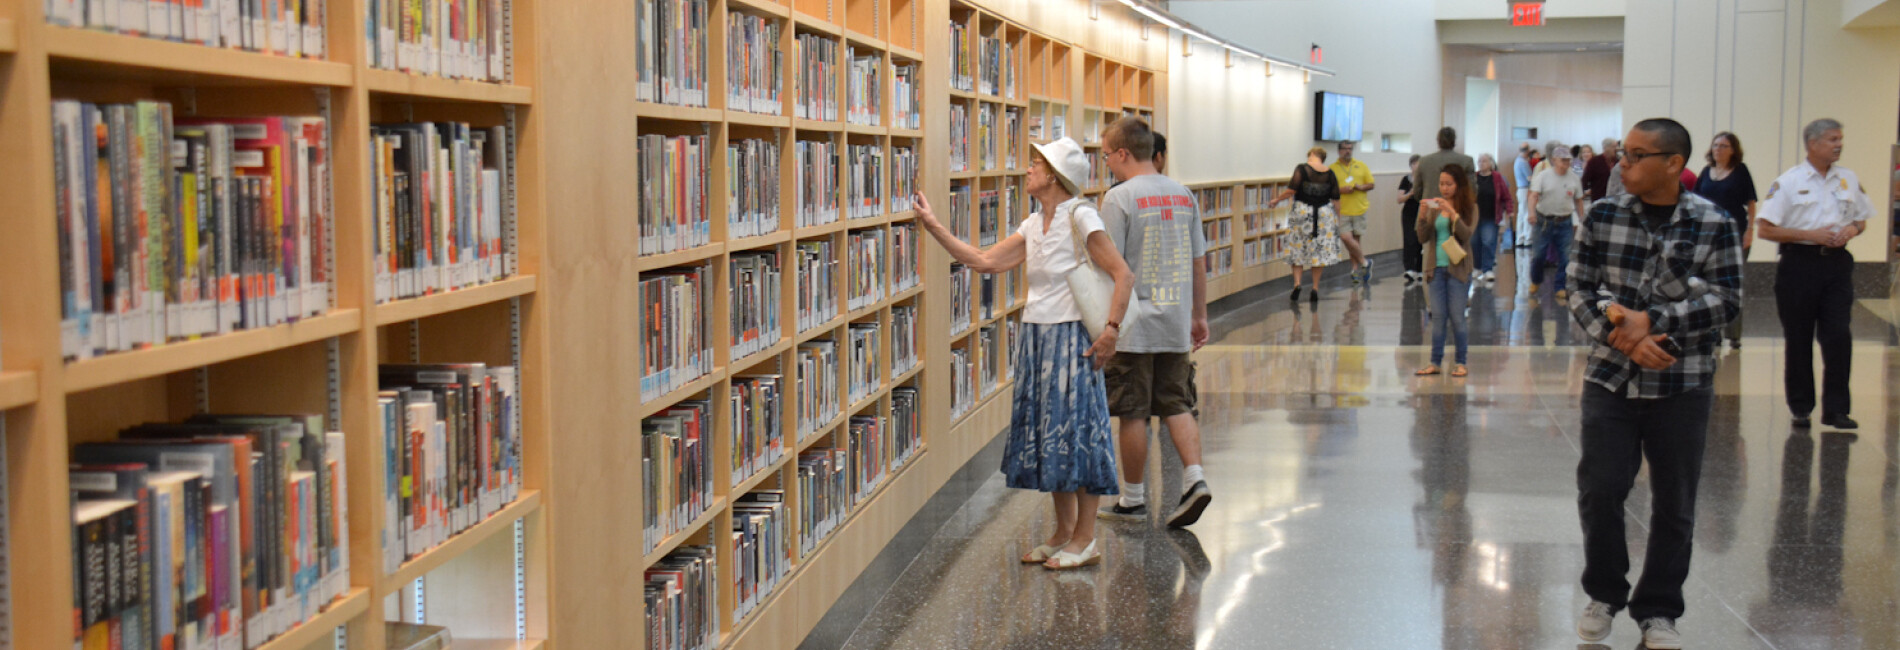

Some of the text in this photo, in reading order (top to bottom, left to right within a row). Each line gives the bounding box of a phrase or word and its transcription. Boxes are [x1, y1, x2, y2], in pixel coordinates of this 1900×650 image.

[1513, 3, 1542, 26] EXIT
[1136, 196, 1148, 209] THE
[1148, 195, 1172, 207] ROLLING
